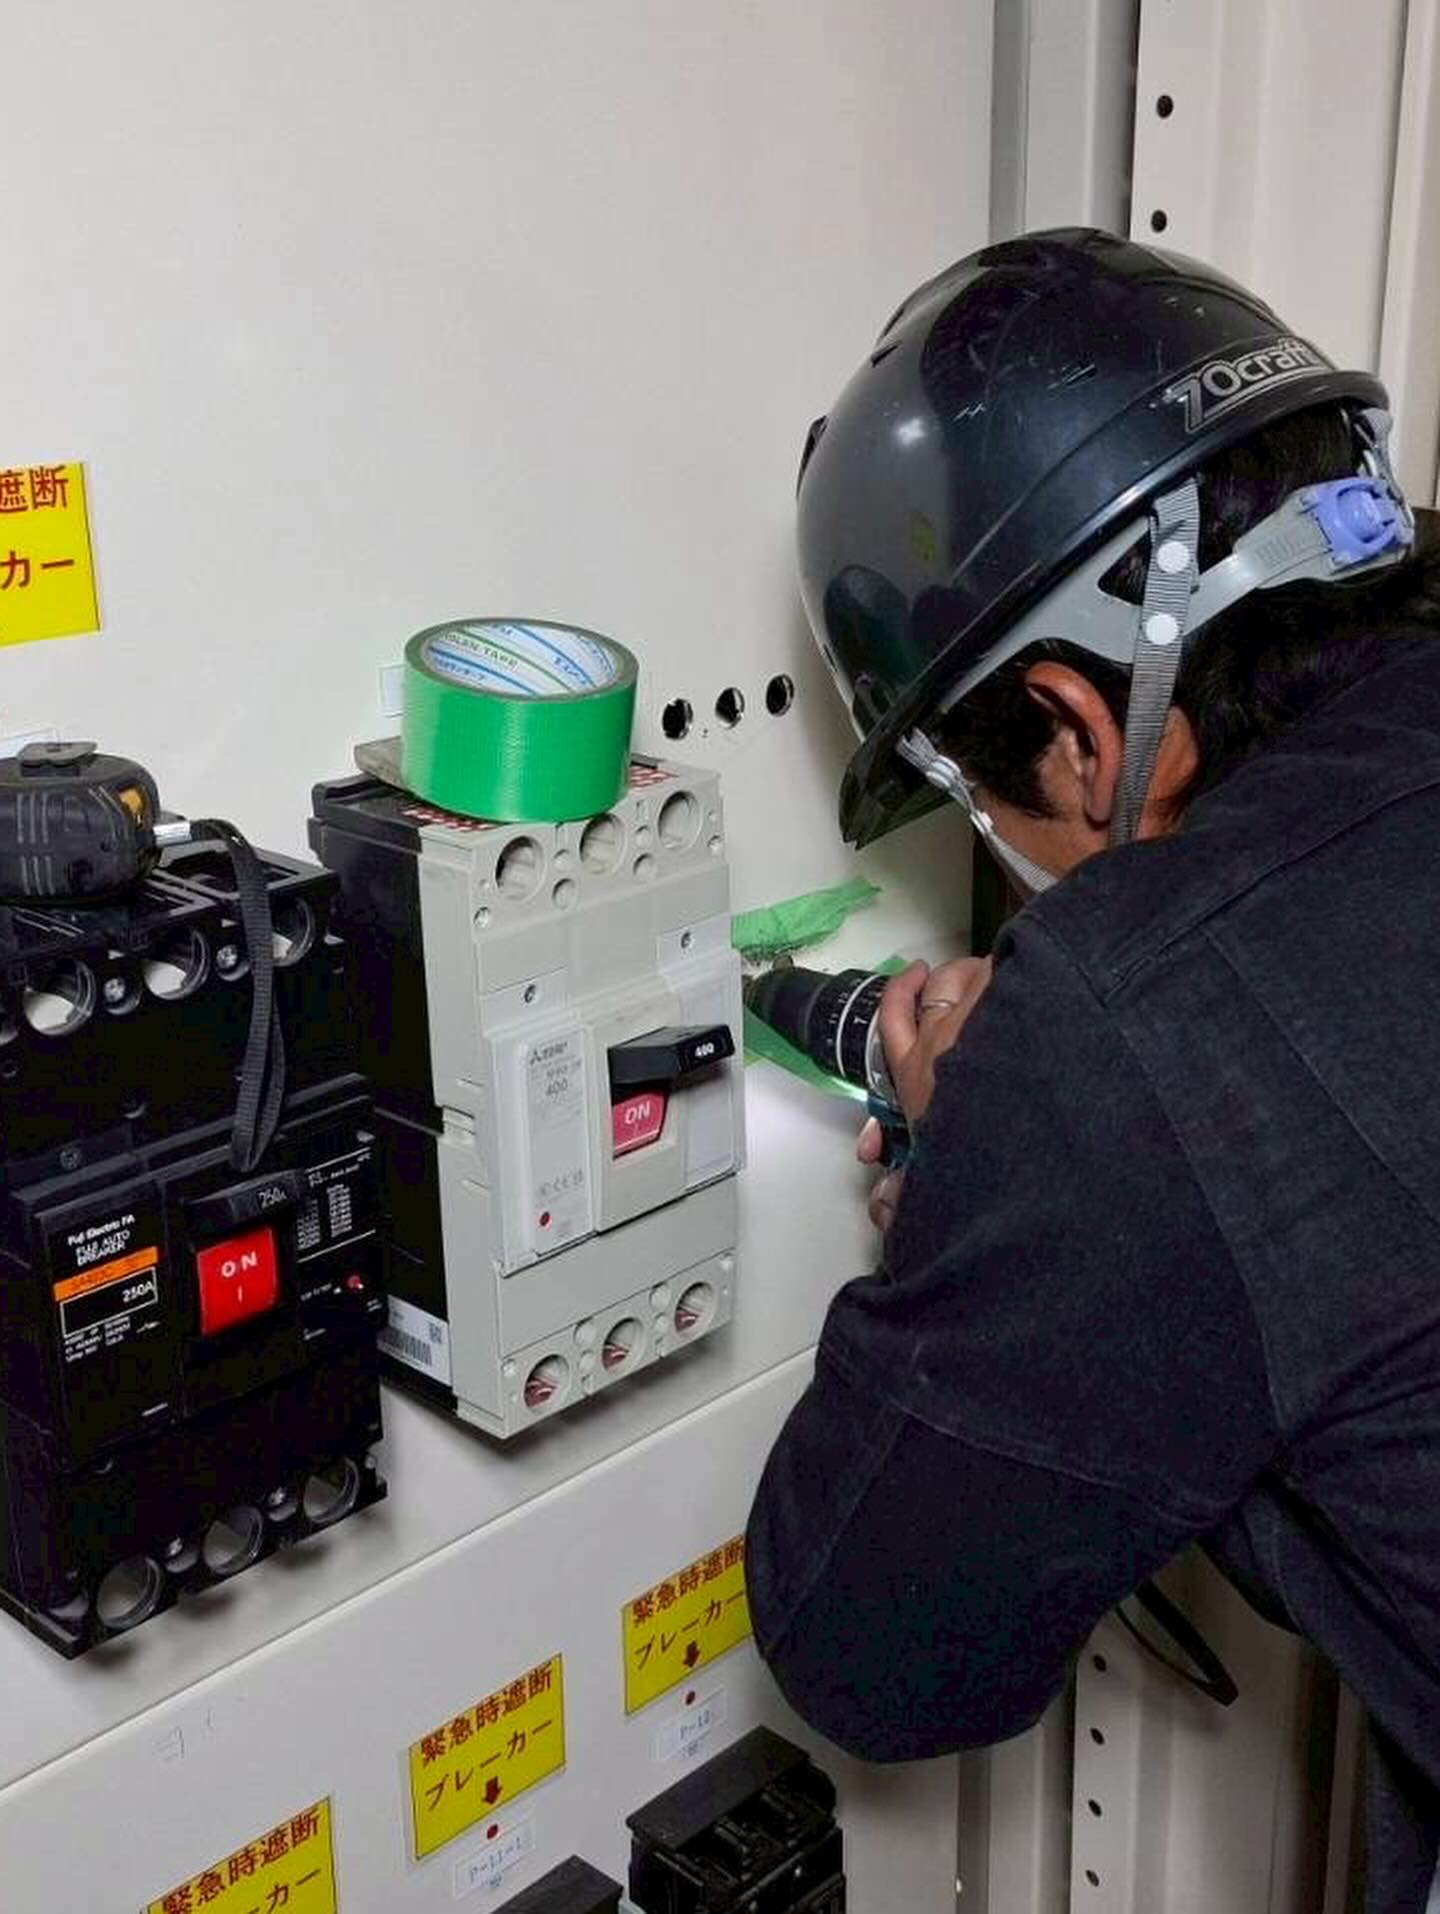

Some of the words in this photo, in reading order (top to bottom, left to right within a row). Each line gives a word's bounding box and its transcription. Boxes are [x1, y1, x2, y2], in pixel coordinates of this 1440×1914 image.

[695, 1042, 715, 1057] 400
[624, 1101, 650, 1124] ON
[221, 1251, 257, 1278] ON
[420, 1663, 552, 1768] 緊急時遮断
[425, 1720, 552, 1812] ブレーカー
